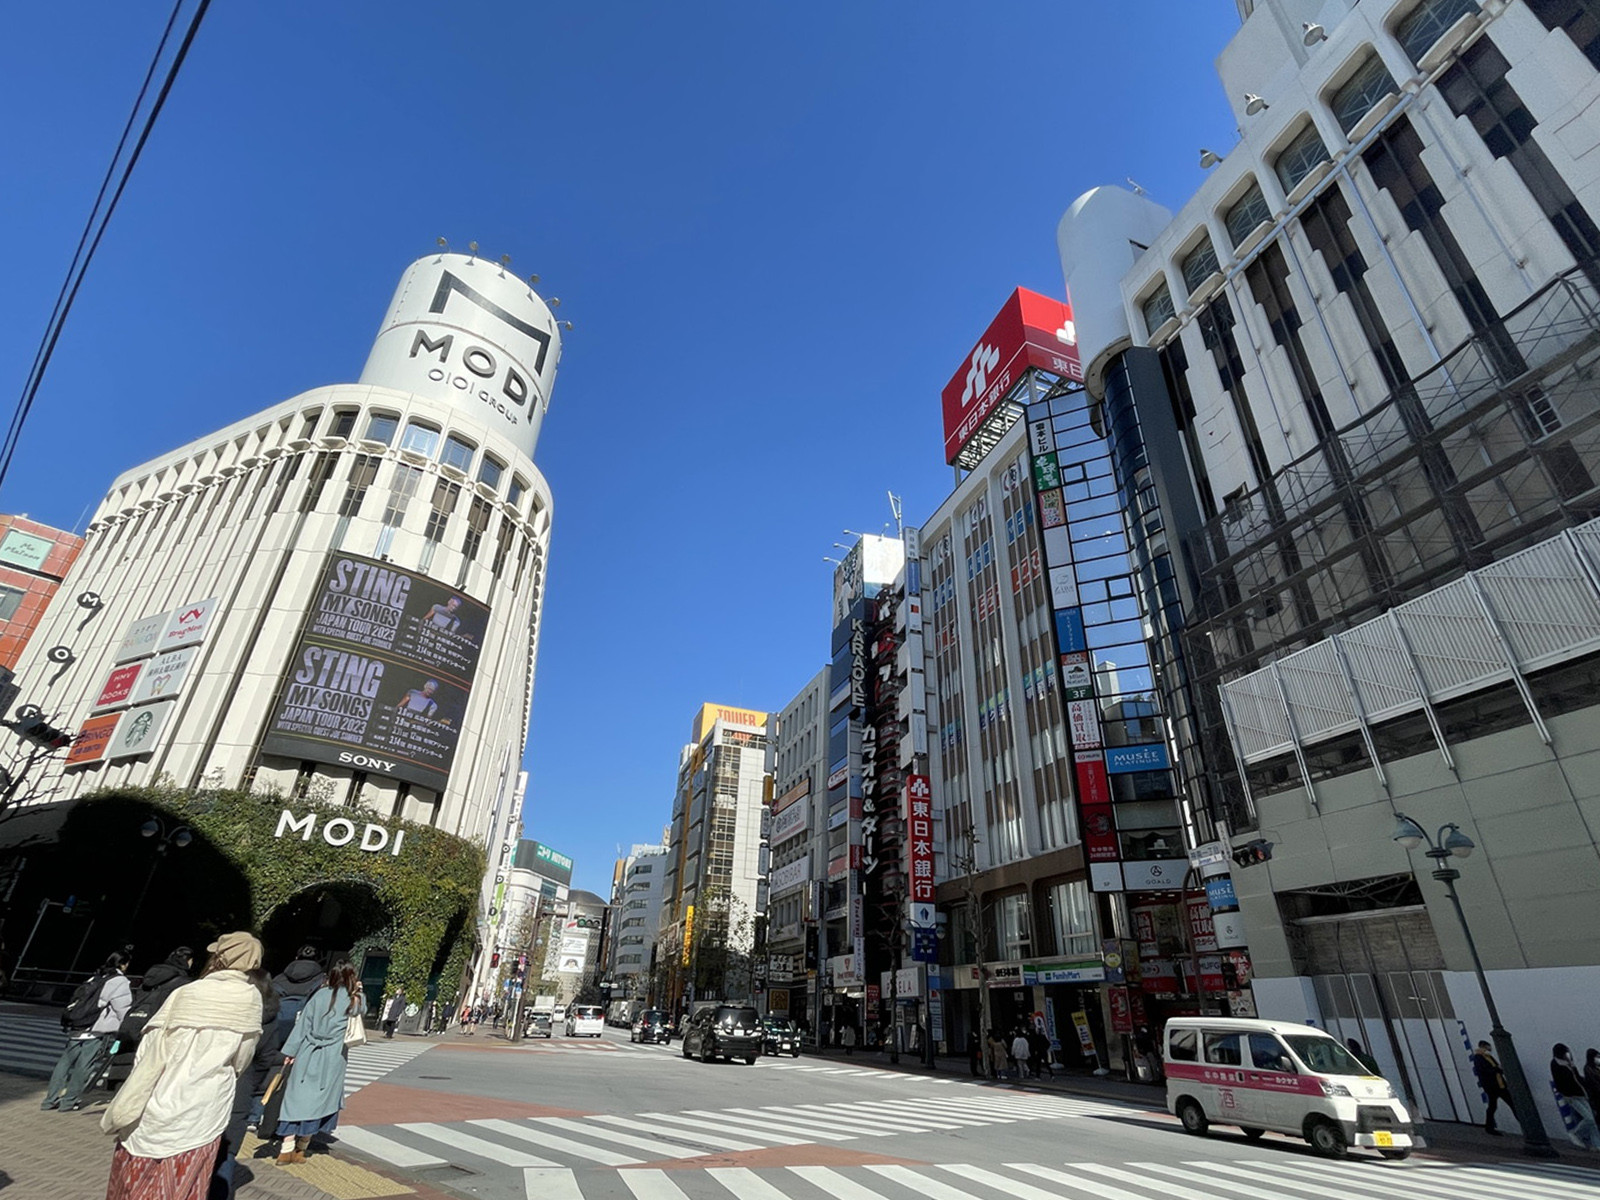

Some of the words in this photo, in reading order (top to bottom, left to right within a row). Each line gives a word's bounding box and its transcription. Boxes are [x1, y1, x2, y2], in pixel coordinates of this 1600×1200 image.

[409, 329, 538, 425] MODI
[479, 389, 518, 425] GROUP
[958, 370, 1011, 443] 東日本銀行
[329, 559, 411, 610] STING
[323, 593, 352, 616] MY
[350, 600, 399, 627] SONGS
[316, 612, 349, 628] JAPAN
[349, 619, 372, 634] TOUR
[371, 626, 396, 642] 2023
[346, 631, 362, 643] GUEST
[113, 672, 132, 682] HMV
[295, 646, 385, 698] STING
[852, 618, 865, 707] KARAOKE
[100, 688, 130, 701] BOOKS
[287, 684, 320, 708] MY
[318, 690, 371, 720] SONGS
[1073, 690, 1086, 698] 3F
[280, 706, 316, 723] JAPAN
[316, 712, 342, 729] TOUR
[342, 717, 368, 735] 2023
[312, 727, 329, 738] GUEST
[717, 709, 756, 727] TOWER
[1071, 702, 1086, 742] 高価買取
[338, 752, 396, 772] SONY
[1114, 748, 1158, 762] MUSÉE
[1114, 758, 1160, 766] PLATINUM
[861, 724, 879, 875] カラオケ&ダーツ
[274, 810, 405, 856] MODI
[551, 852, 572, 869] NITORI
[912, 800, 932, 898] 東日本銀行
[1052, 970, 1080, 979] FamilyMart
